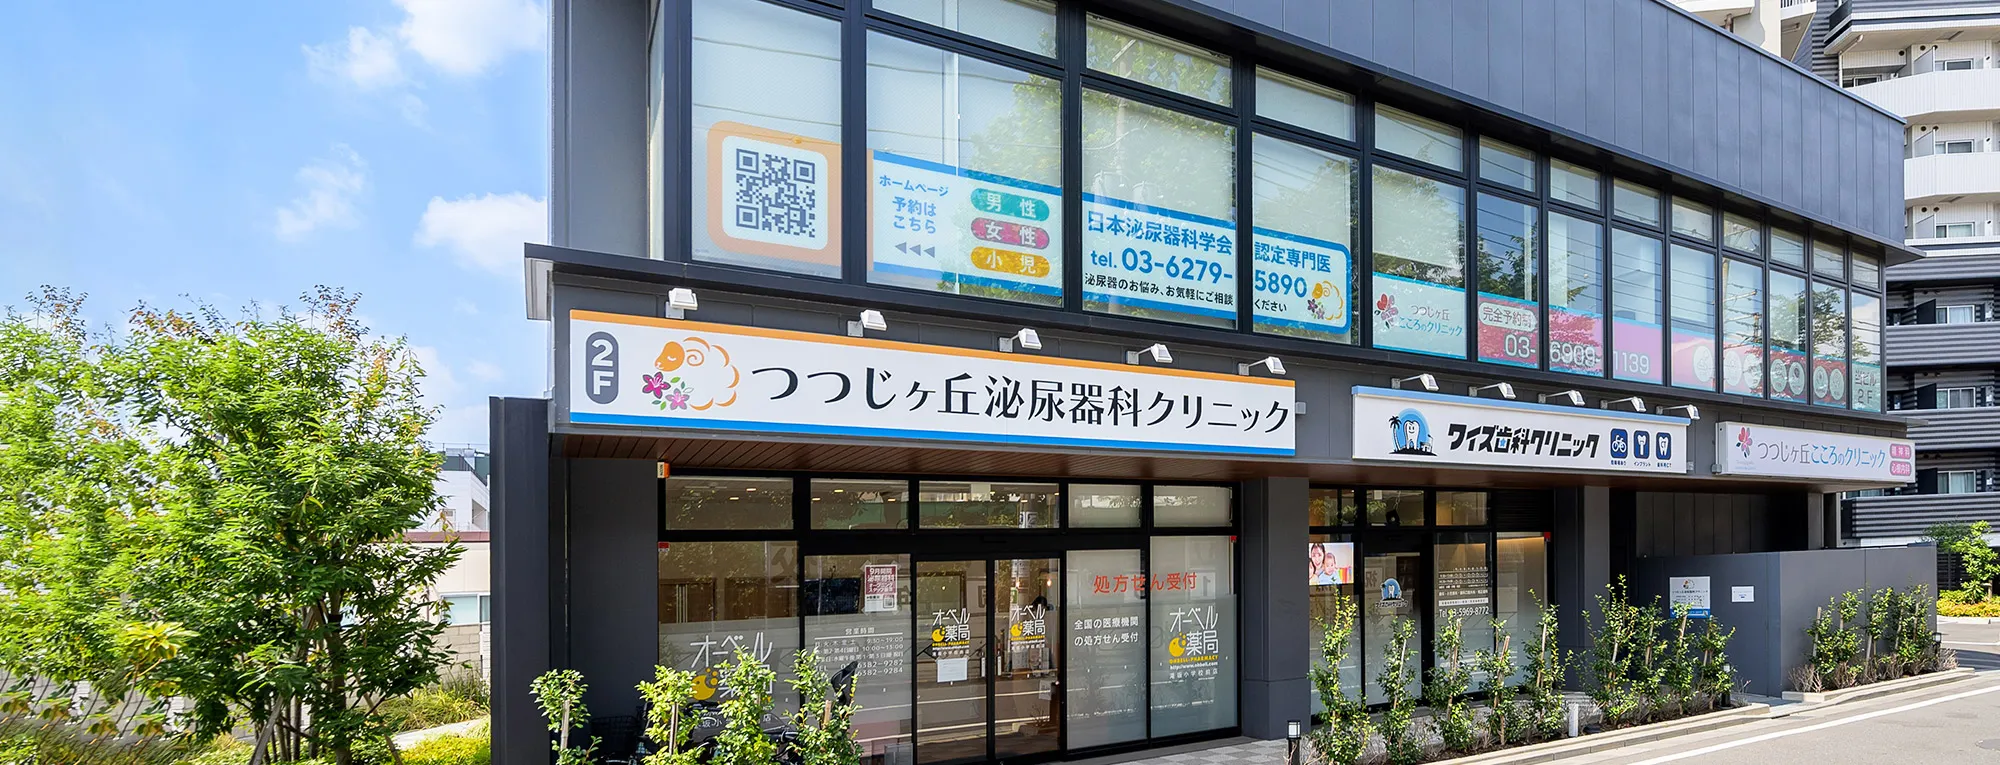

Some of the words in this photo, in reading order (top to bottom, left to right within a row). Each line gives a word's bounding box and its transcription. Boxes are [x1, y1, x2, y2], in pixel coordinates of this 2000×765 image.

[879, 174, 949, 197] ホームページ
[892, 196, 937, 217] 予約は
[893, 215, 937, 234] こちら
[1087, 210, 1232, 256] 日本泌尿器科学会
[1254, 241, 1331, 273] 認定専門医
[1091, 250, 1117, 268] tel.
[1121, 247, 1233, 284] 03-6279-
[1254, 268, 1308, 298] 5890
[1084, 273, 1233, 306] 泌尿器のお悩み、お気軽にご相談
[1255, 298, 1288, 314] ください
[1400, 317, 1463, 336] こころのクリニック
[1613, 350, 1649, 375] 1139
[1448, 423, 1600, 459] ワイズ歯科クリニック
[1093, 571, 1197, 594] 処方せん受付
[932, 607, 971, 626] オーベル
[1010, 603, 1046, 621] オーベル
[1074, 616, 1139, 630] 全国の医療機関
[1169, 605, 1219, 632] オーベル
[945, 624, 971, 642] 薬局
[1022, 620, 1046, 636] 薬局
[1074, 632, 1139, 647] の処方せん受付
[690, 631, 773, 669] オーベル
[1186, 630, 1219, 656] 薬局
